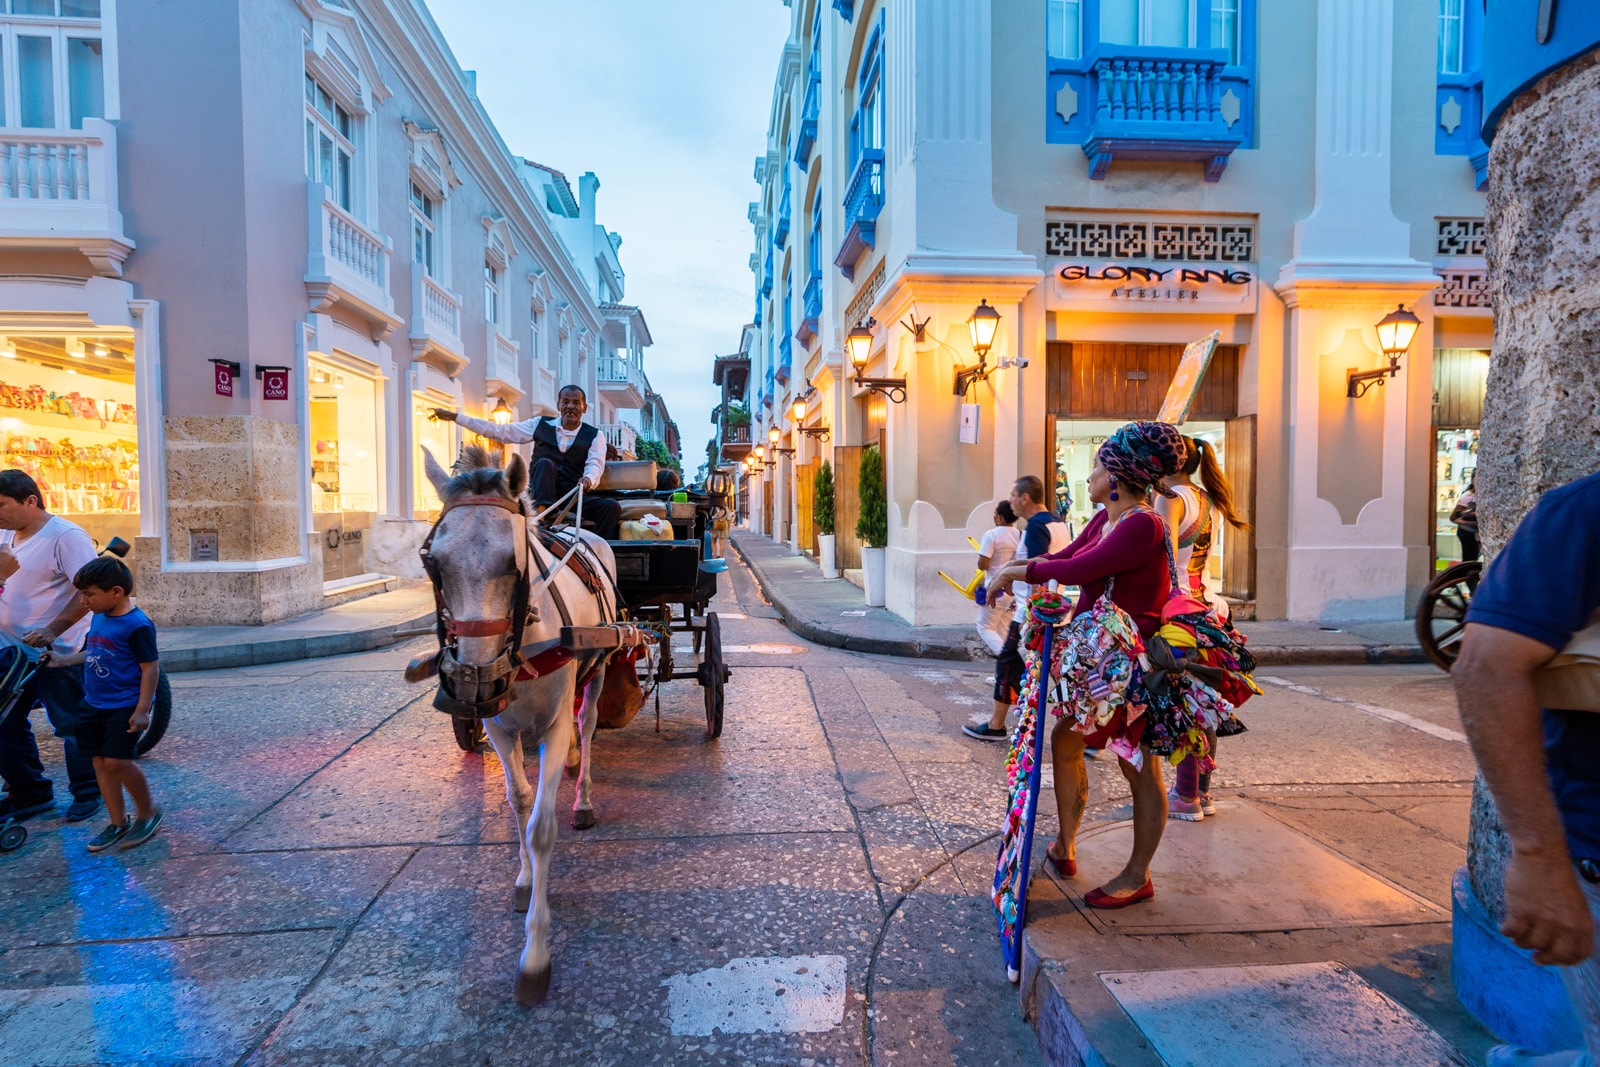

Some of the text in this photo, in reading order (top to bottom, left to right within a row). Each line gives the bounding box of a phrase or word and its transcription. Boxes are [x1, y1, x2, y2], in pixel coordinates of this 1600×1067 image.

[1060, 265, 1251, 285] GLORY ANG
[1111, 288, 1199, 299] ATELIER
[217, 384, 231, 392] CANO
[342, 530, 362, 541] CANO
